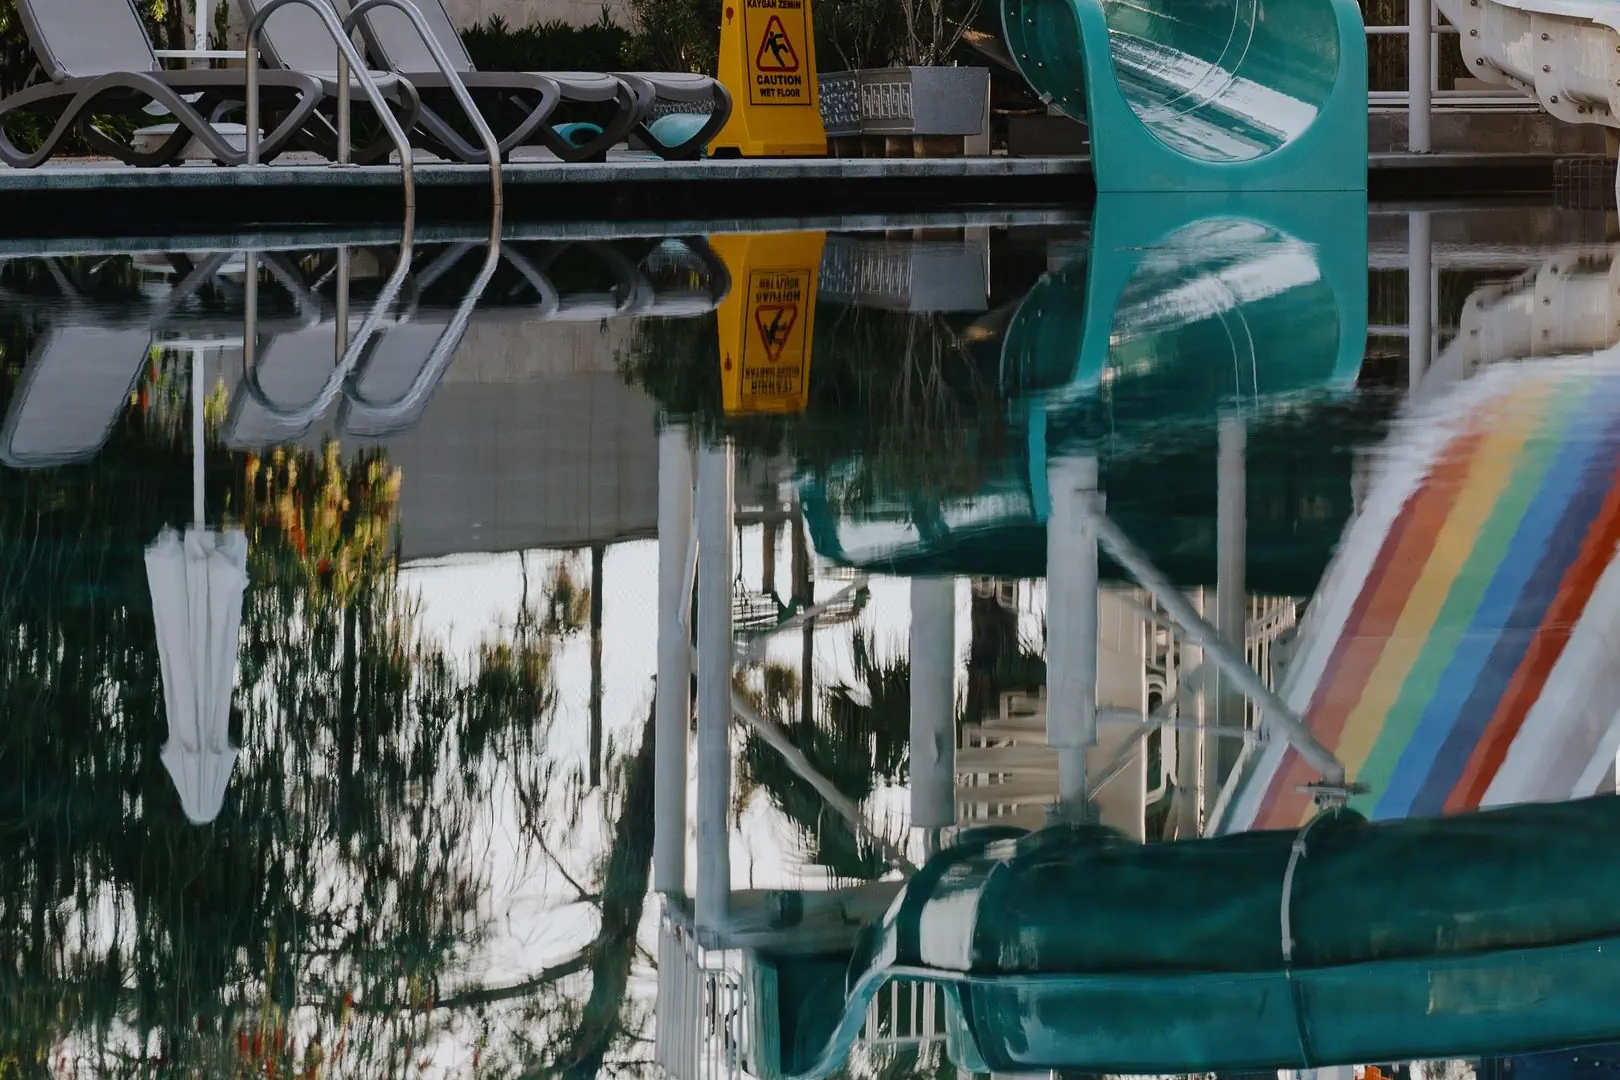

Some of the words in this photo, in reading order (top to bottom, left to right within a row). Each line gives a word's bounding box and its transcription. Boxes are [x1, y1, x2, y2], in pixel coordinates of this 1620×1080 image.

[747, 0, 777, 9] KAYGAN
[757, 74, 802, 86] CAUTION
[760, 88, 776, 97] WET
[777, 88, 801, 98] FLOOR
